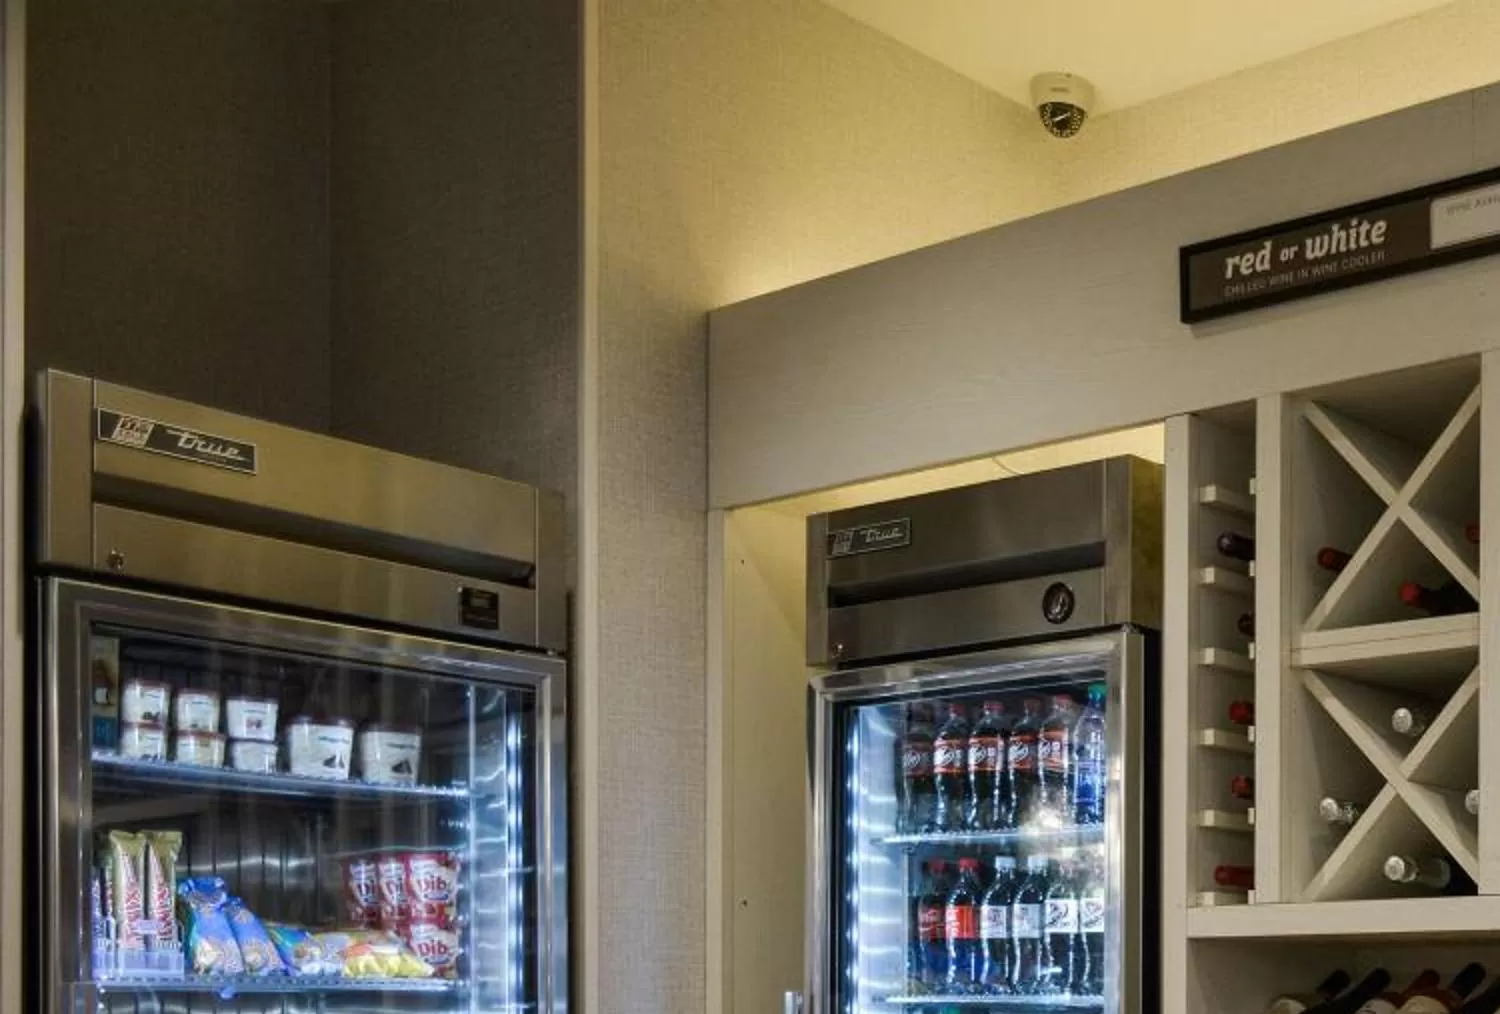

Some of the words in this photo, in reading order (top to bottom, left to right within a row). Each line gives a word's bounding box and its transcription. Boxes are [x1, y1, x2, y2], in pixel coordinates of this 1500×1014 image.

[1224, 239, 1273, 279] red
[1279, 244, 1299, 262] or
[1304, 217, 1388, 261] white
